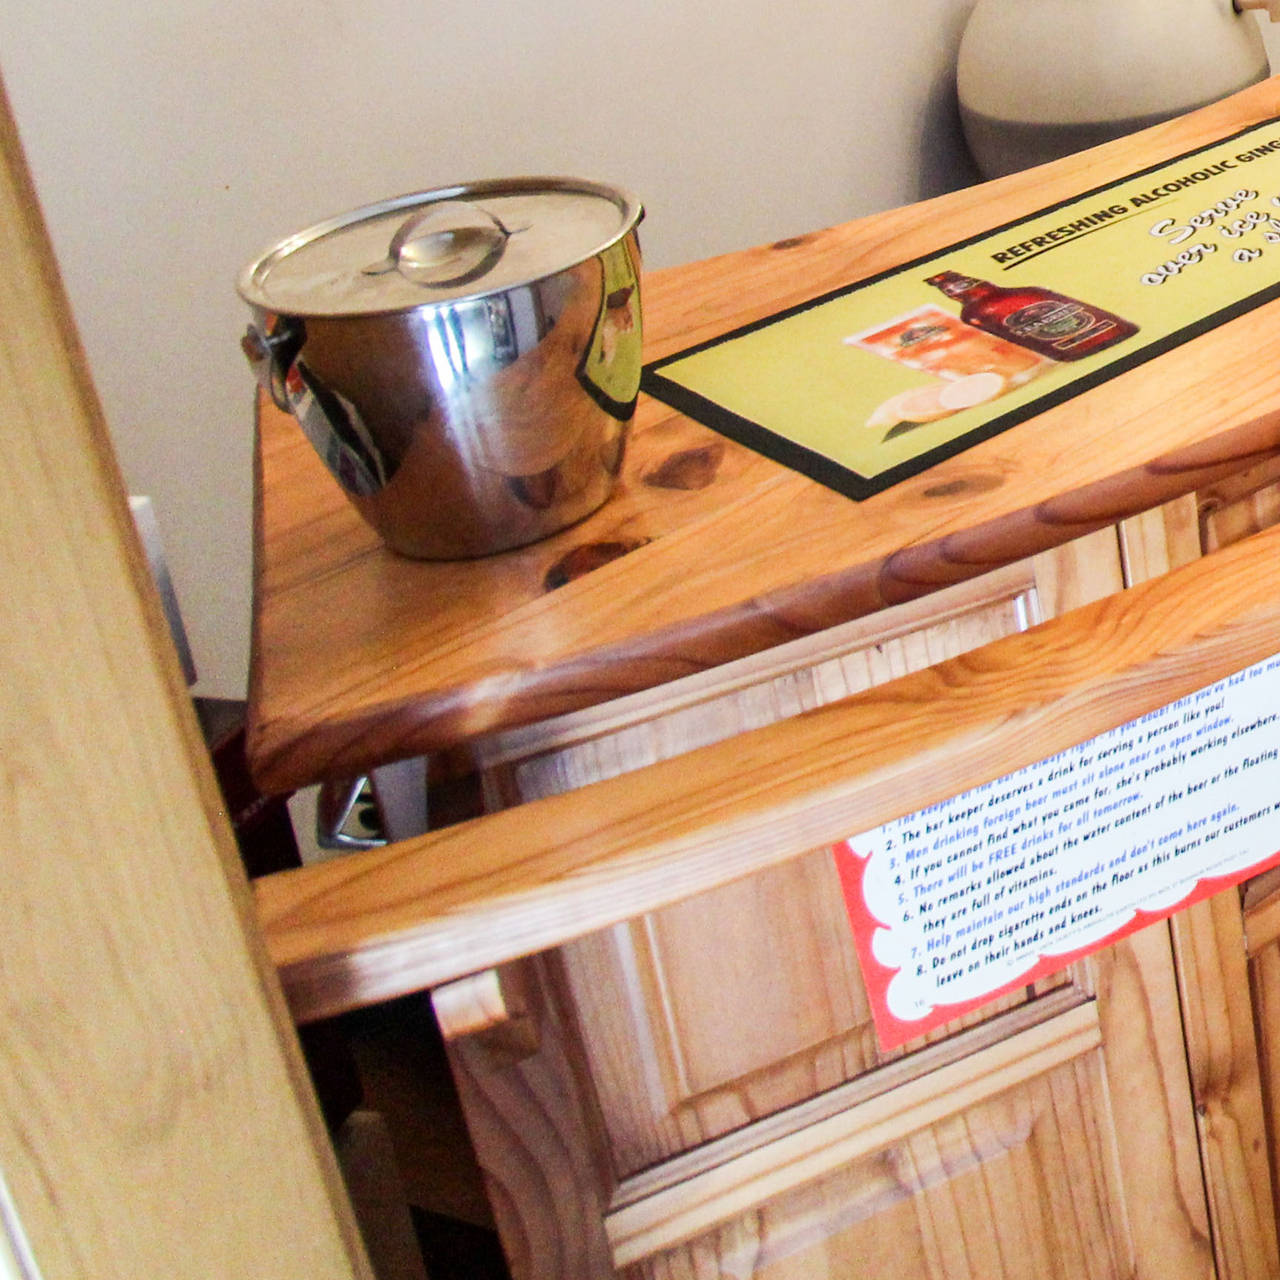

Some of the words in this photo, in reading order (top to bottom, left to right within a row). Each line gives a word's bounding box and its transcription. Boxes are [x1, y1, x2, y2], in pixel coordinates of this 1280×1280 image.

[991, 203, 1129, 264] REFRESHING
[1129, 160, 1238, 208] ALCOHOLIC
[1140, 242, 1218, 286] over
[1217, 211, 1271, 238] ice
[1150, 187, 1260, 245] Serve
[1233, 247, 1264, 264] a
[1227, 670, 1247, 688] had
[1249, 666, 1263, 680] too
[901, 830, 921, 845] The
[925, 819, 944, 835] bar
[947, 802, 984, 825] keeper
[987, 782, 1034, 808] deserves
[1047, 761, 1075, 783] drink
[1078, 756, 1094, 769] for
[1096, 739, 1134, 761] serving
[1147, 720, 1179, 743] person
[1182, 710, 1201, 725] like
[1204, 696, 1225, 719] you!
[905, 846, 929, 863] Men
[932, 824, 979, 851] drinking
[983, 806, 1021, 830] foreign
[1025, 794, 1048, 812] beer
[1052, 779, 1078, 800] must
[1081, 772, 1095, 787] sit
[1098, 760, 1125, 780] alone
[1129, 750, 1151, 766] near
[1154, 744, 1166, 756] an
[1169, 732, 1193, 750] open
[910, 864, 920, 881] If
[923, 859, 943, 878] you
[946, 839, 983, 864] cannot
[986, 826, 1009, 848] find
[1012, 816, 1038, 836] what
[1041, 809, 1059, 826] you
[1063, 795, 1090, 814] came
[1115, 772, 1140, 791] she's
[1143, 751, 1187, 781] probably
[1190, 735, 1228, 758] working
[913, 879, 944, 899] There
[947, 863, 968, 884] will
[971, 860, 984, 873] be
[988, 843, 1017, 866] FREE
[1020, 829, 1054, 851] drinks
[1058, 821, 1073, 835] for
[1076, 810, 1090, 827] all
[919, 901, 934, 916] No
[937, 880, 982, 908] remarks
[986, 856, 1026, 886] allowed
[1029, 844, 1059, 867] about
[1062, 837, 1079, 851] the
[1082, 822, 1111, 842] water
[1114, 803, 1152, 829] content
[1154, 795, 1166, 810] of
[1168, 790, 1183, 804] the
[1186, 779, 1208, 796] beer
[1210, 774, 1221, 785] or
[1224, 766, 1239, 779] the
[1242, 748, 1278, 771] floating
[923, 916, 947, 934] they
[950, 907, 968, 921] are
[971, 892, 990, 912] full
[994, 885, 1006, 901] of
[926, 933, 951, 953] Help
[955, 909, 1004, 940] maintain
[1007, 900, 1025, 915] our
[1028, 885, 1051, 906] high
[1055, 862, 1105, 894] standards
[1108, 849, 1127, 869] and
[1129, 839, 1155, 859] don't
[1157, 828, 1183, 847] come
[1186, 817, 1208, 833] here
[932, 956, 946, 970] Do
[949, 944, 967, 962] not
[970, 934, 995, 952] drop
[998, 911, 1045, 939] cigarette
[1048, 896, 1072, 916] ends
[1075, 891, 1088, 903] on
[1091, 881, 1108, 896] the
[1111, 868, 1135, 887] floor
[1137, 862, 1148, 875] as
[1152, 851, 1170, 868] this
[1174, 838, 1201, 858] burns
[1204, 829, 1220, 843] our
[1223, 806, 1271, 834] customers
[936, 968, 964, 988] leave
[967, 960, 980, 974] on
[984, 945, 1010, 966] their
[1013, 929, 1044, 952] hands
[1048, 915, 1067, 936] and
